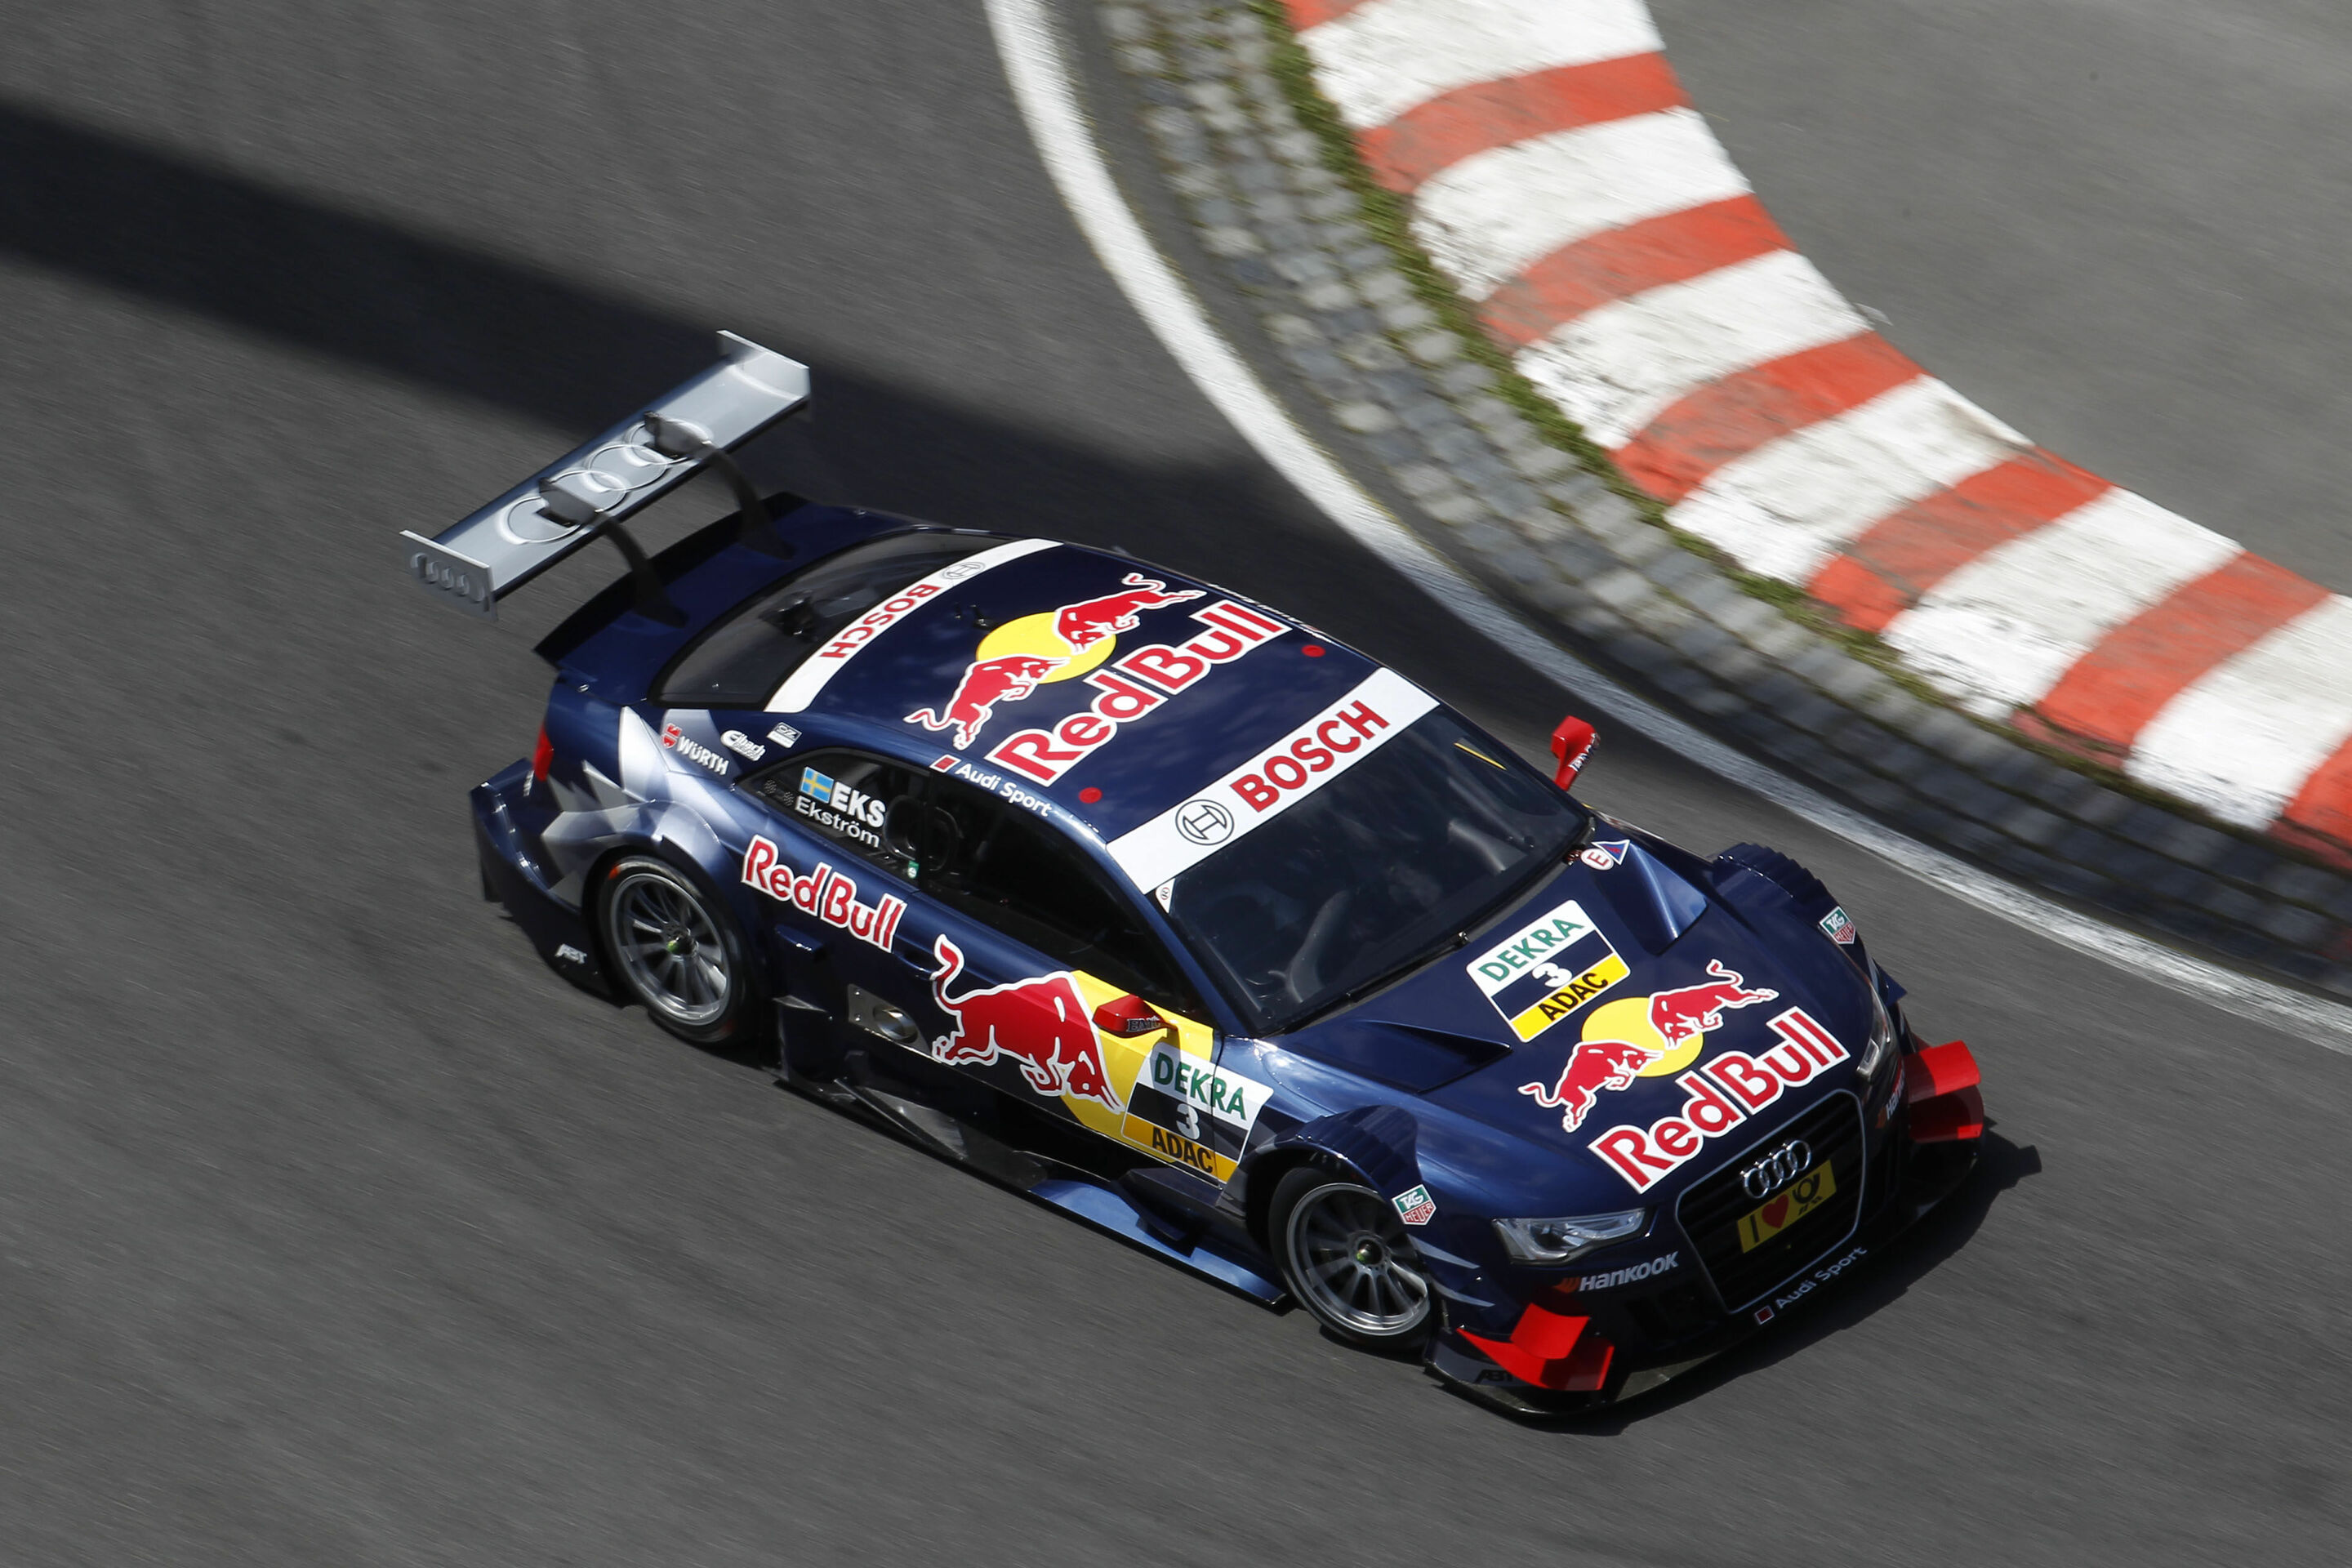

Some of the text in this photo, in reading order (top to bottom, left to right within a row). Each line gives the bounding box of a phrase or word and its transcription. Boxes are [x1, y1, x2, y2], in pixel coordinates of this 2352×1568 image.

[820, 584, 942, 658] BOSCH
[677, 736, 729, 775] WÜRTH
[1230, 700, 1391, 813] BOSCH
[830, 782, 886, 827] EKS
[955, 764, 1053, 817] Audi Sport
[795, 795, 880, 848] Ekström
[1587, 851, 1610, 866] E
[1826, 914, 1845, 930] TAG
[1477, 919, 1585, 982] DEKRA
[1531, 962, 1573, 987] 3
[1538, 973, 1609, 1022] ADAC
[1155, 1052, 1247, 1120] DEKRA
[1176, 1103, 1200, 1140] 3
[1152, 1127, 1214, 1174] ADAC
[1400, 1192, 1423, 1209] TAG
[1405, 1203, 1435, 1222] HEUER
[1775, 1247, 1868, 1309] Audi Sport
